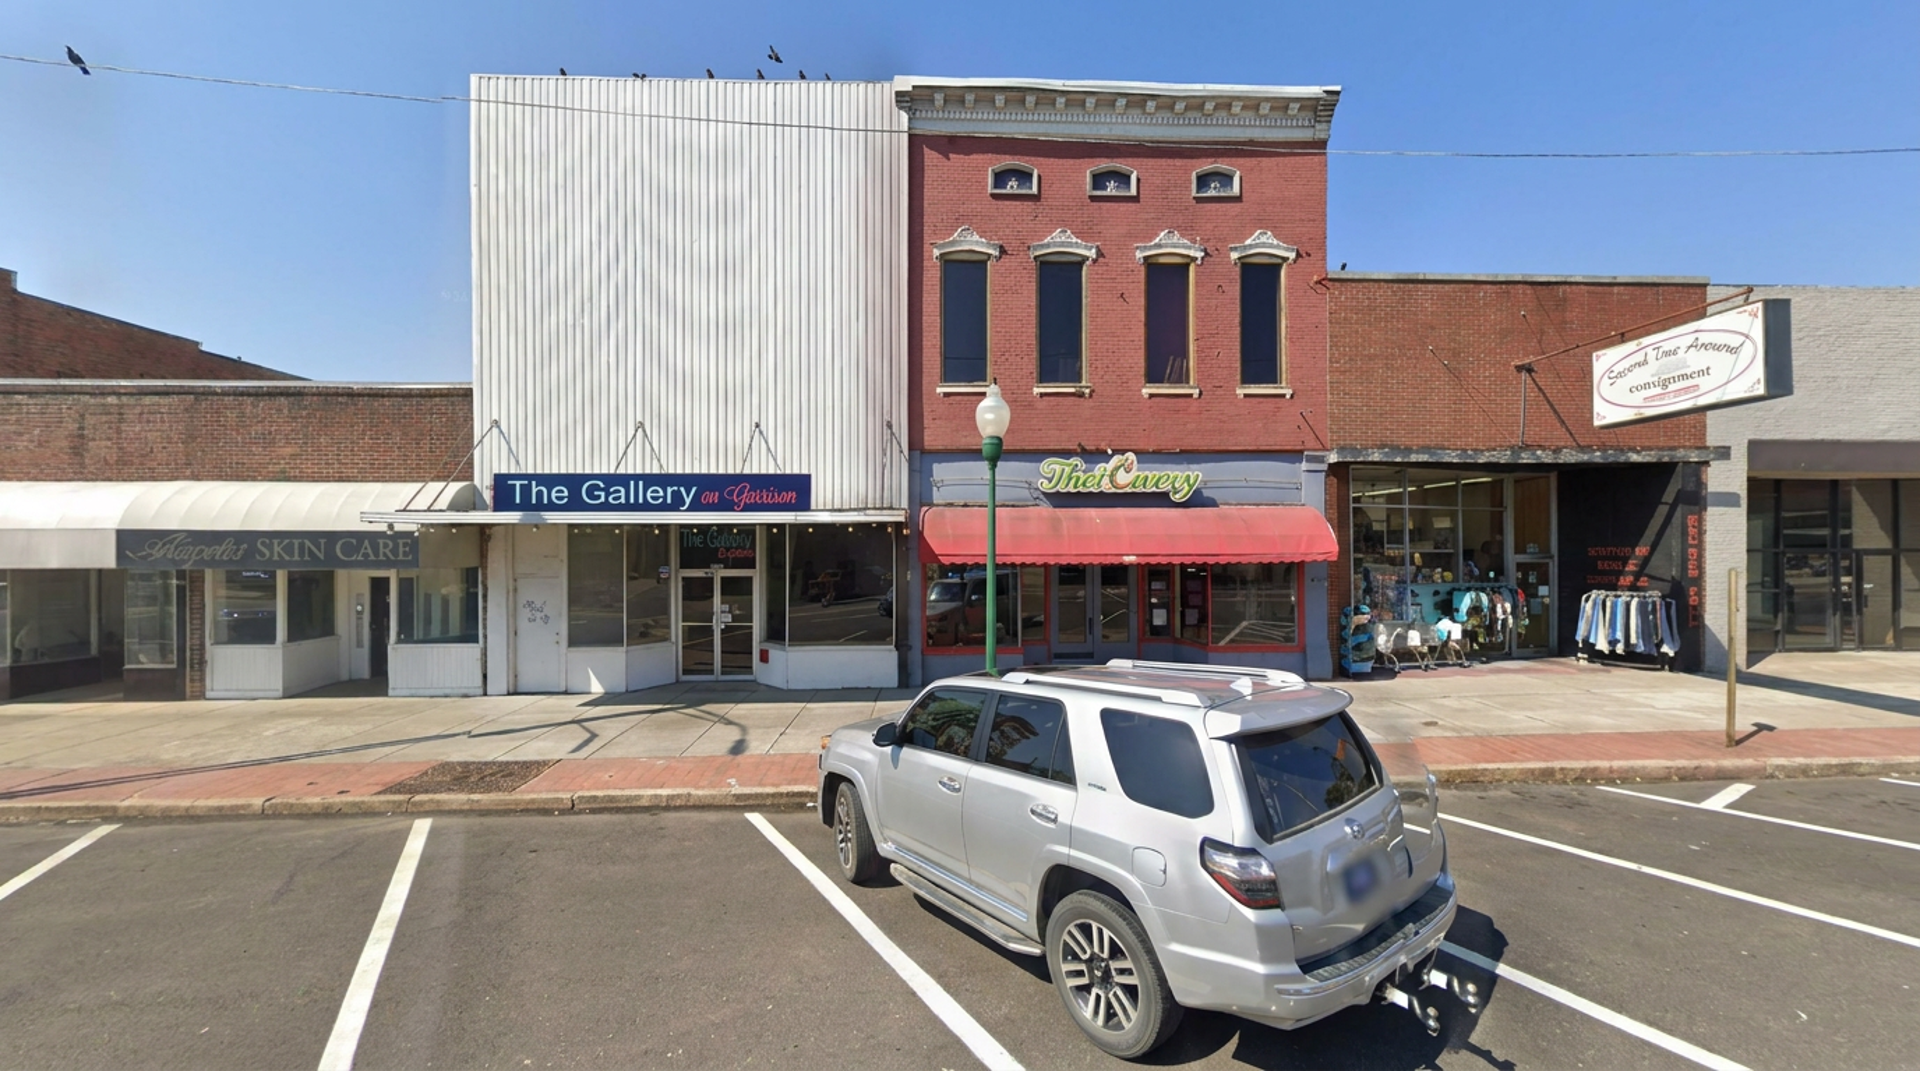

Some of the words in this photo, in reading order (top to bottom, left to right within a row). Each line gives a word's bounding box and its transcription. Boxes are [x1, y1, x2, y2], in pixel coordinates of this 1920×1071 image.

[1629, 366, 1711, 394] consignment
[507, 480, 569, 505] The
[581, 479, 697, 510] Gallery
[255, 538, 327, 561] SKIN
[335, 538, 413, 561] CARE
